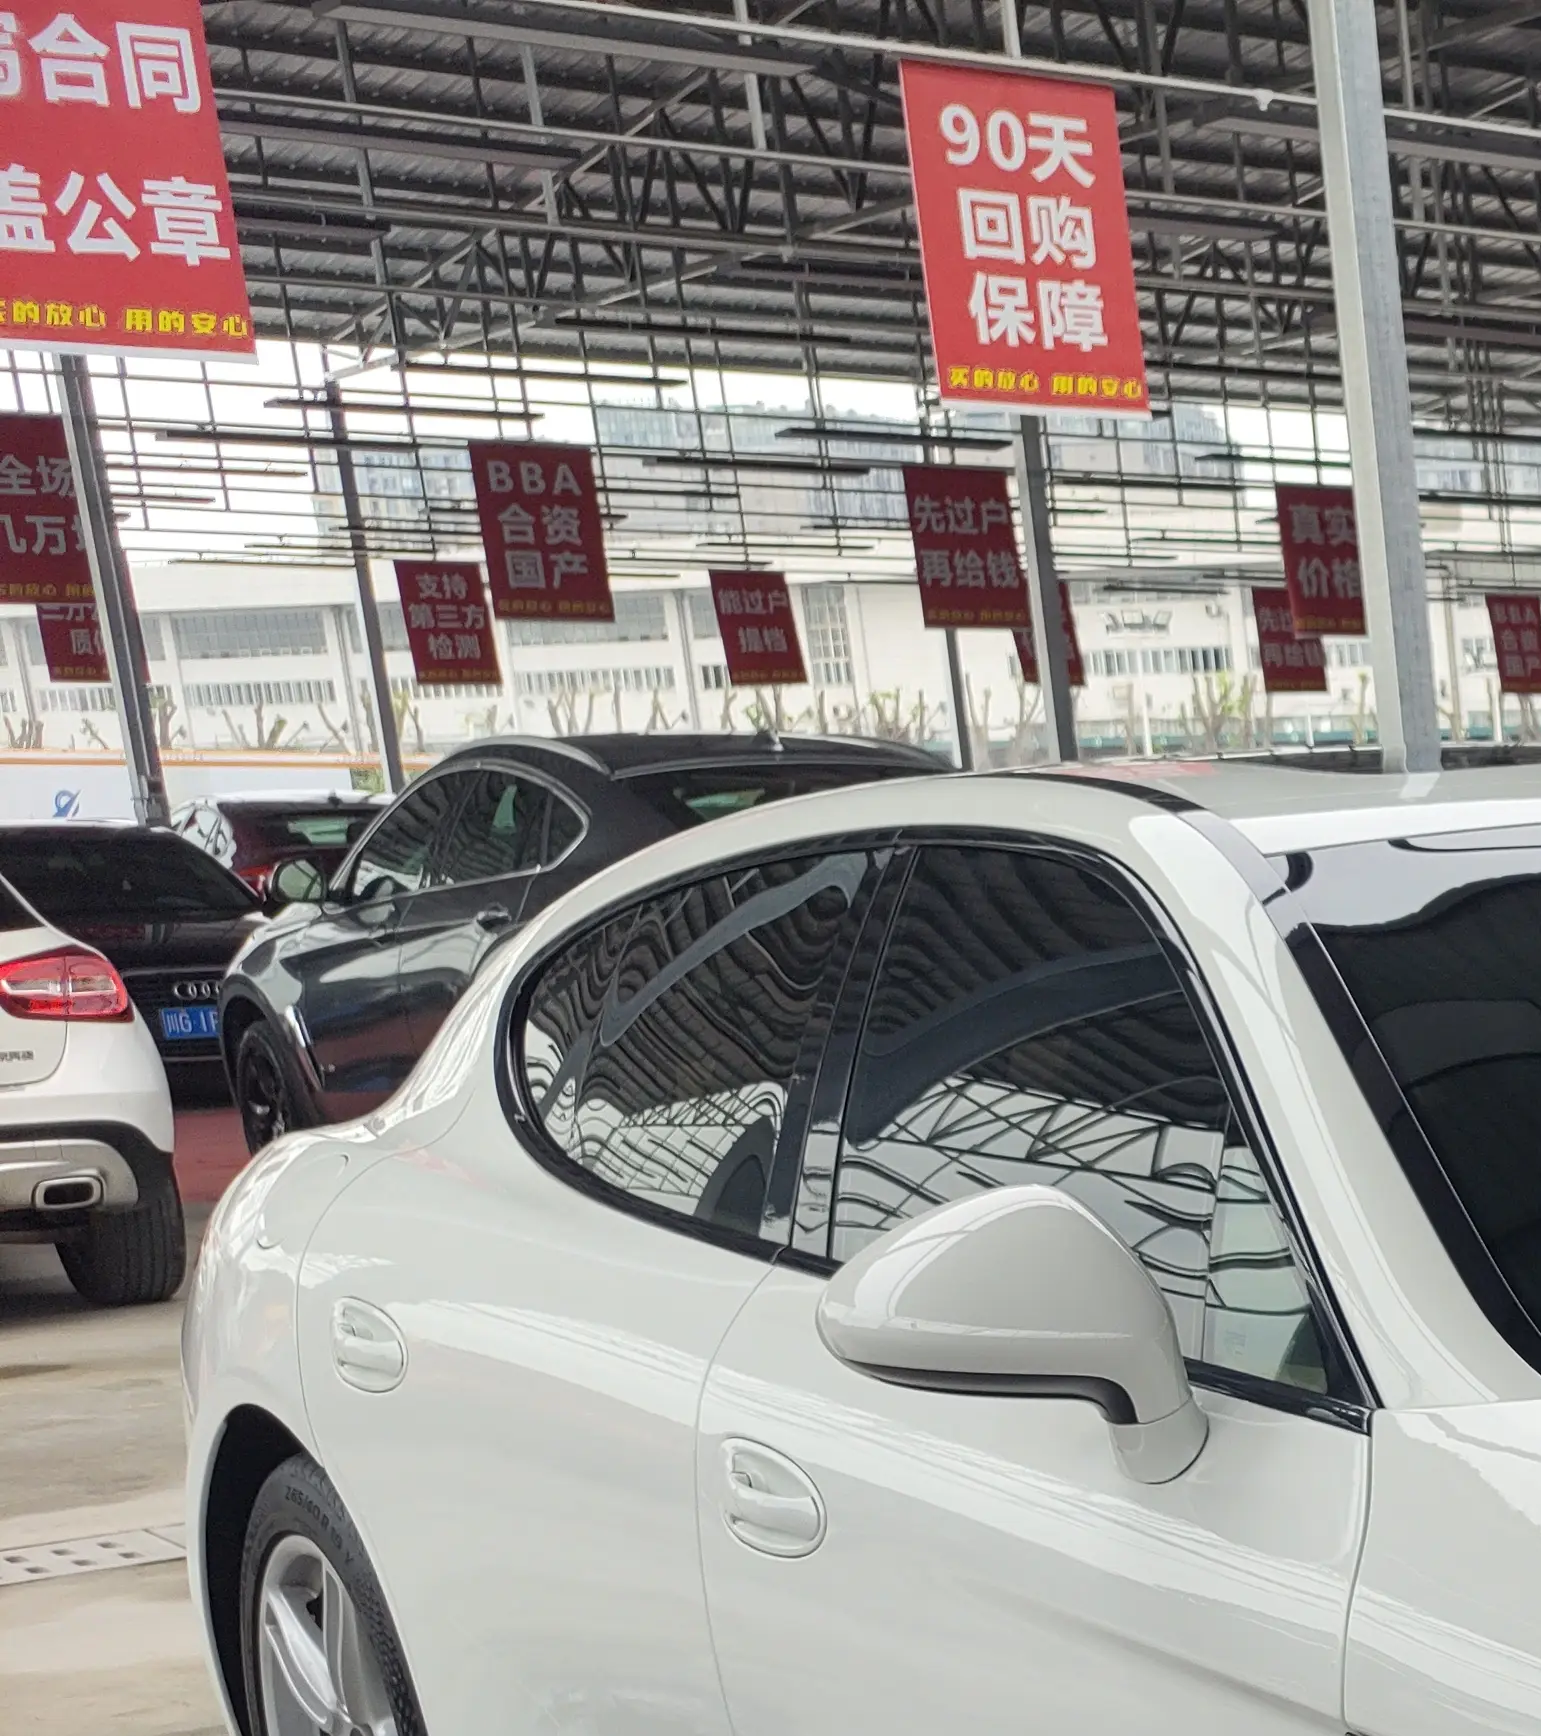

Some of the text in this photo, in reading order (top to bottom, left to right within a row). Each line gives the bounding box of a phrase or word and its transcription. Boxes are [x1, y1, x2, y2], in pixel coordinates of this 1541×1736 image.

[0, 12, 202, 114] 合同
[940, 103, 1096, 189] 90天
[0, 163, 231, 267] 盖公章
[957, 187, 1097, 270] 回购
[0, 300, 248, 339] 的放心 用的安心
[968, 270, 1108, 353] 保障
[487, 460, 582, 497] BBA
[498, 503, 582, 546] 合资
[912, 495, 1009, 536] 先过户
[416, 573, 468, 600] 支持
[505, 550, 588, 590] 国产
[920, 548, 1022, 590] 再给钱
[408, 603, 485, 630] 第三方
